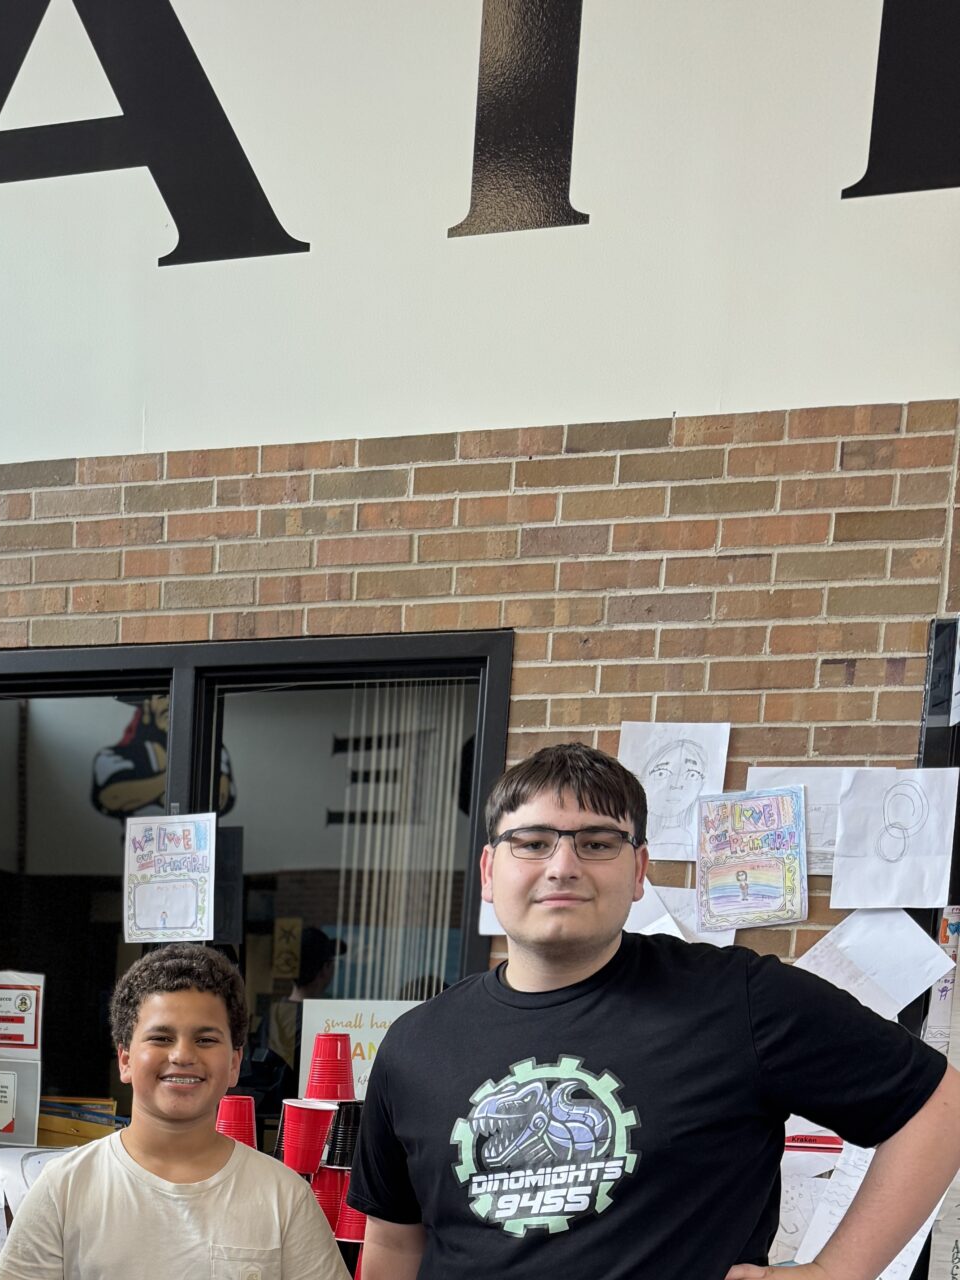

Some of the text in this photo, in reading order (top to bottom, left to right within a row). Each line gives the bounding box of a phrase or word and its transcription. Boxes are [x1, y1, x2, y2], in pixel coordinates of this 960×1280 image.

[324, 1013, 363, 1033] small
[791, 1136, 817, 1144] Kraken
[495, 1186, 592, 1218] 9455
